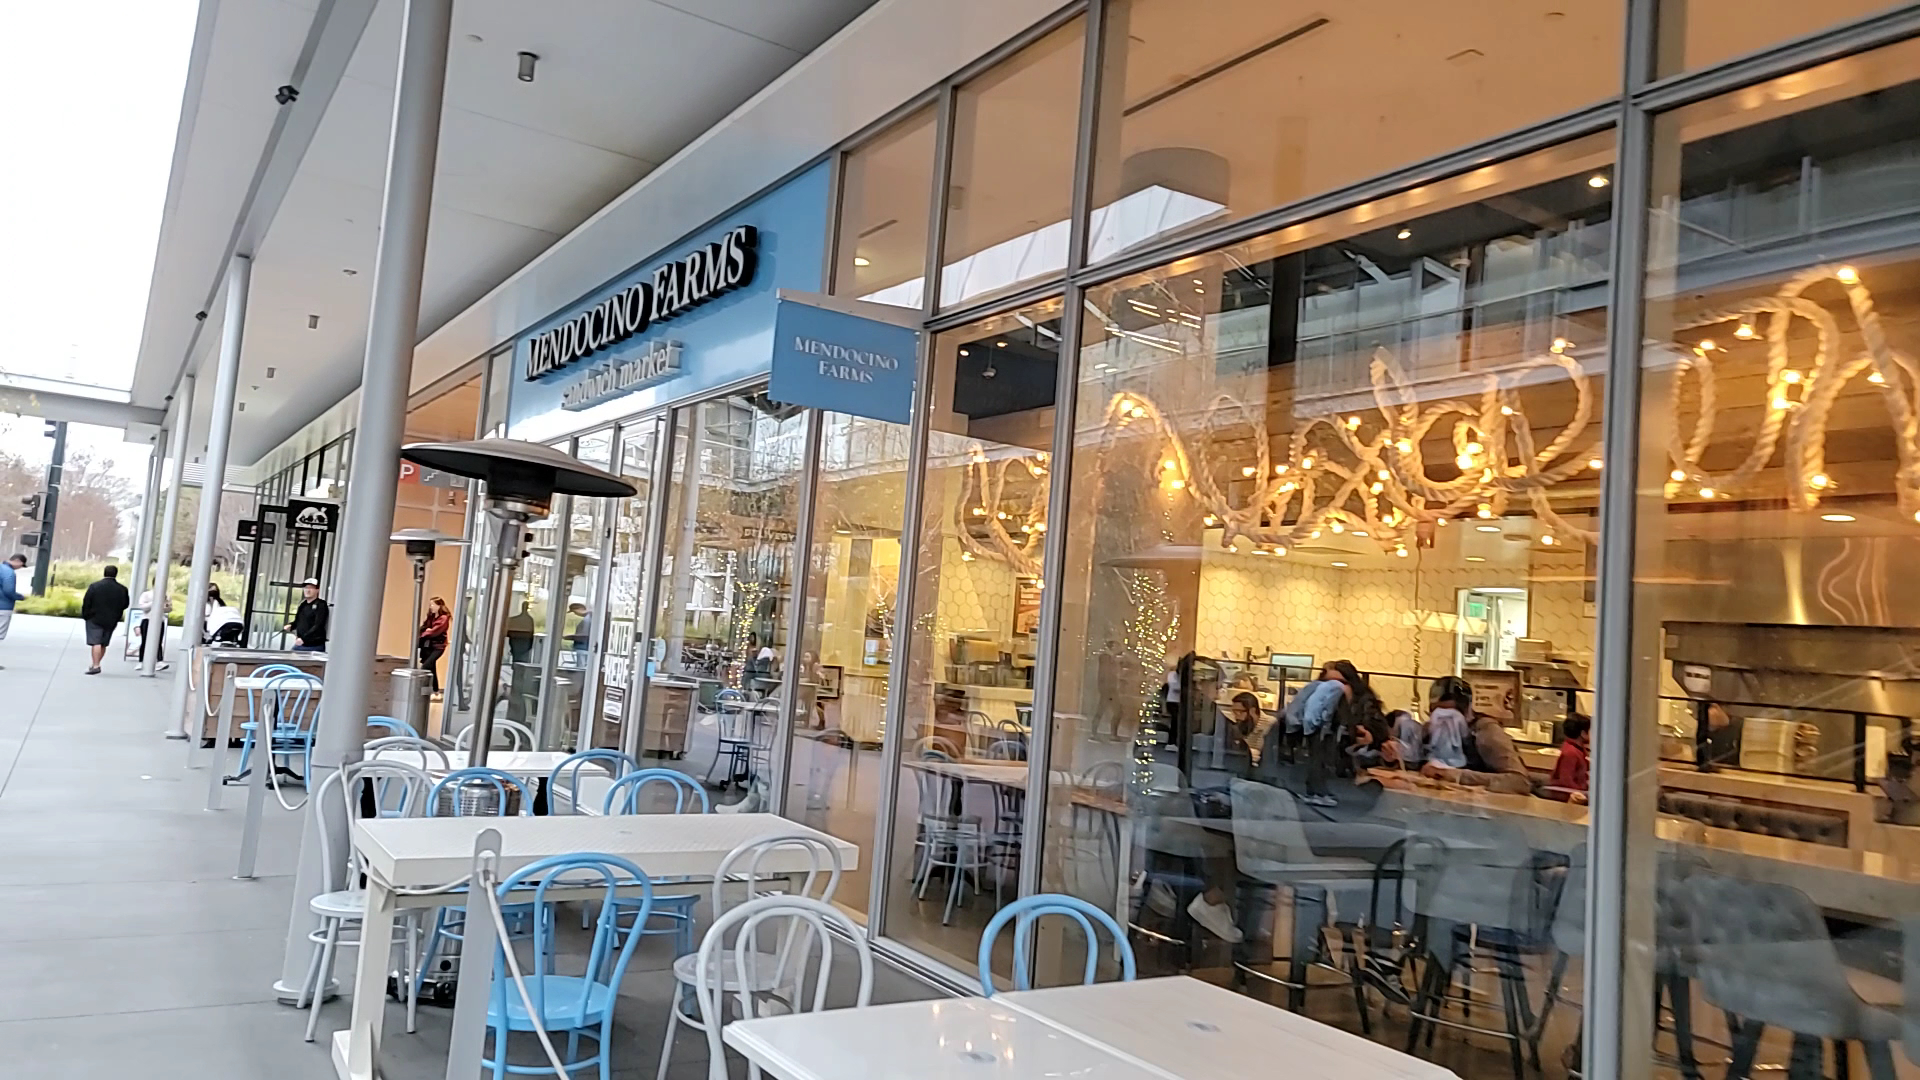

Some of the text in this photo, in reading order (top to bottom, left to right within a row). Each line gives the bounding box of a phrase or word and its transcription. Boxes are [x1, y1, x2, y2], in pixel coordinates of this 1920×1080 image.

[524, 225, 756, 381] MENDOCINO FARMS
[619, 338, 684, 390] market
[794, 336, 899, 371] MENDOCINO
[818, 360, 874, 384] FARMS
[400, 463, 415, 479] P
